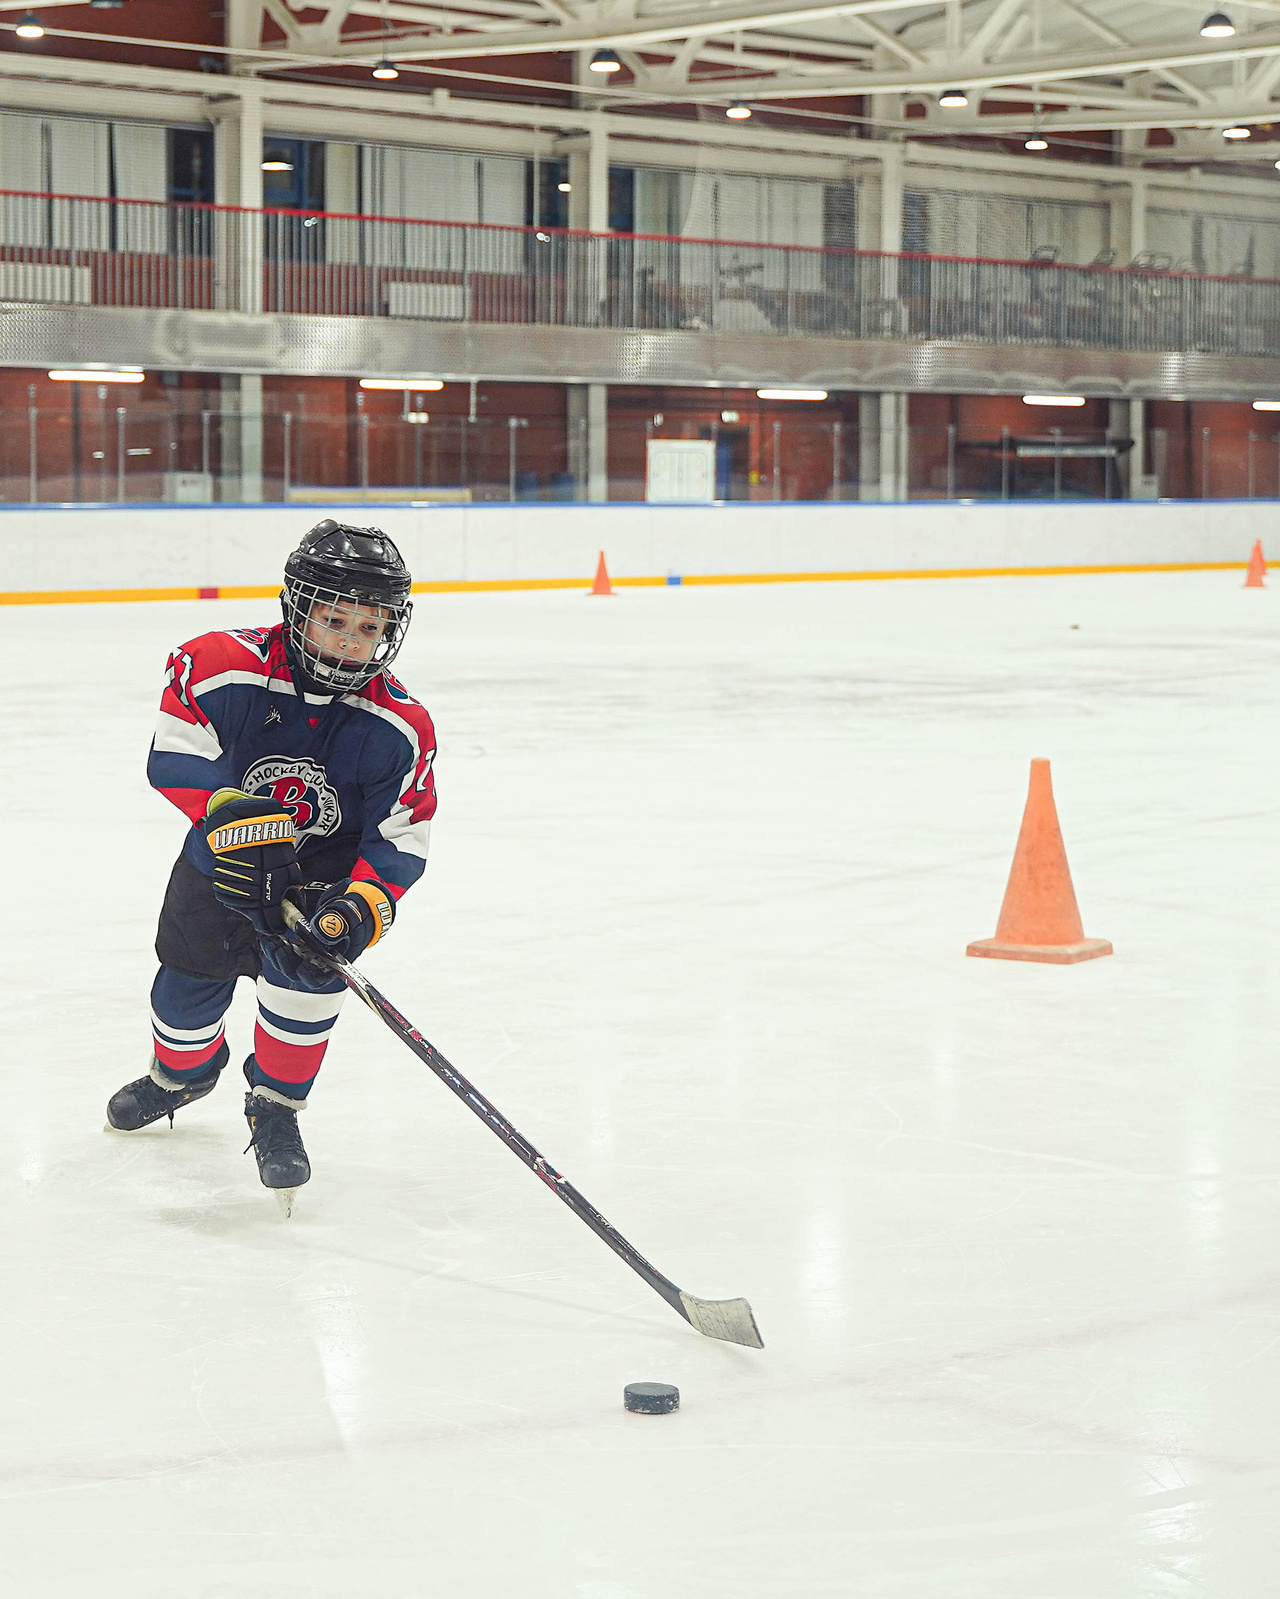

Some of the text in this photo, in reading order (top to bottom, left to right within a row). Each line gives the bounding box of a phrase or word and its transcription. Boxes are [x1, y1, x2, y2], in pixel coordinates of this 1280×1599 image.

[252, 765, 324, 795] HOCKEY CLU
[214, 820, 295, 850] WARRIO
